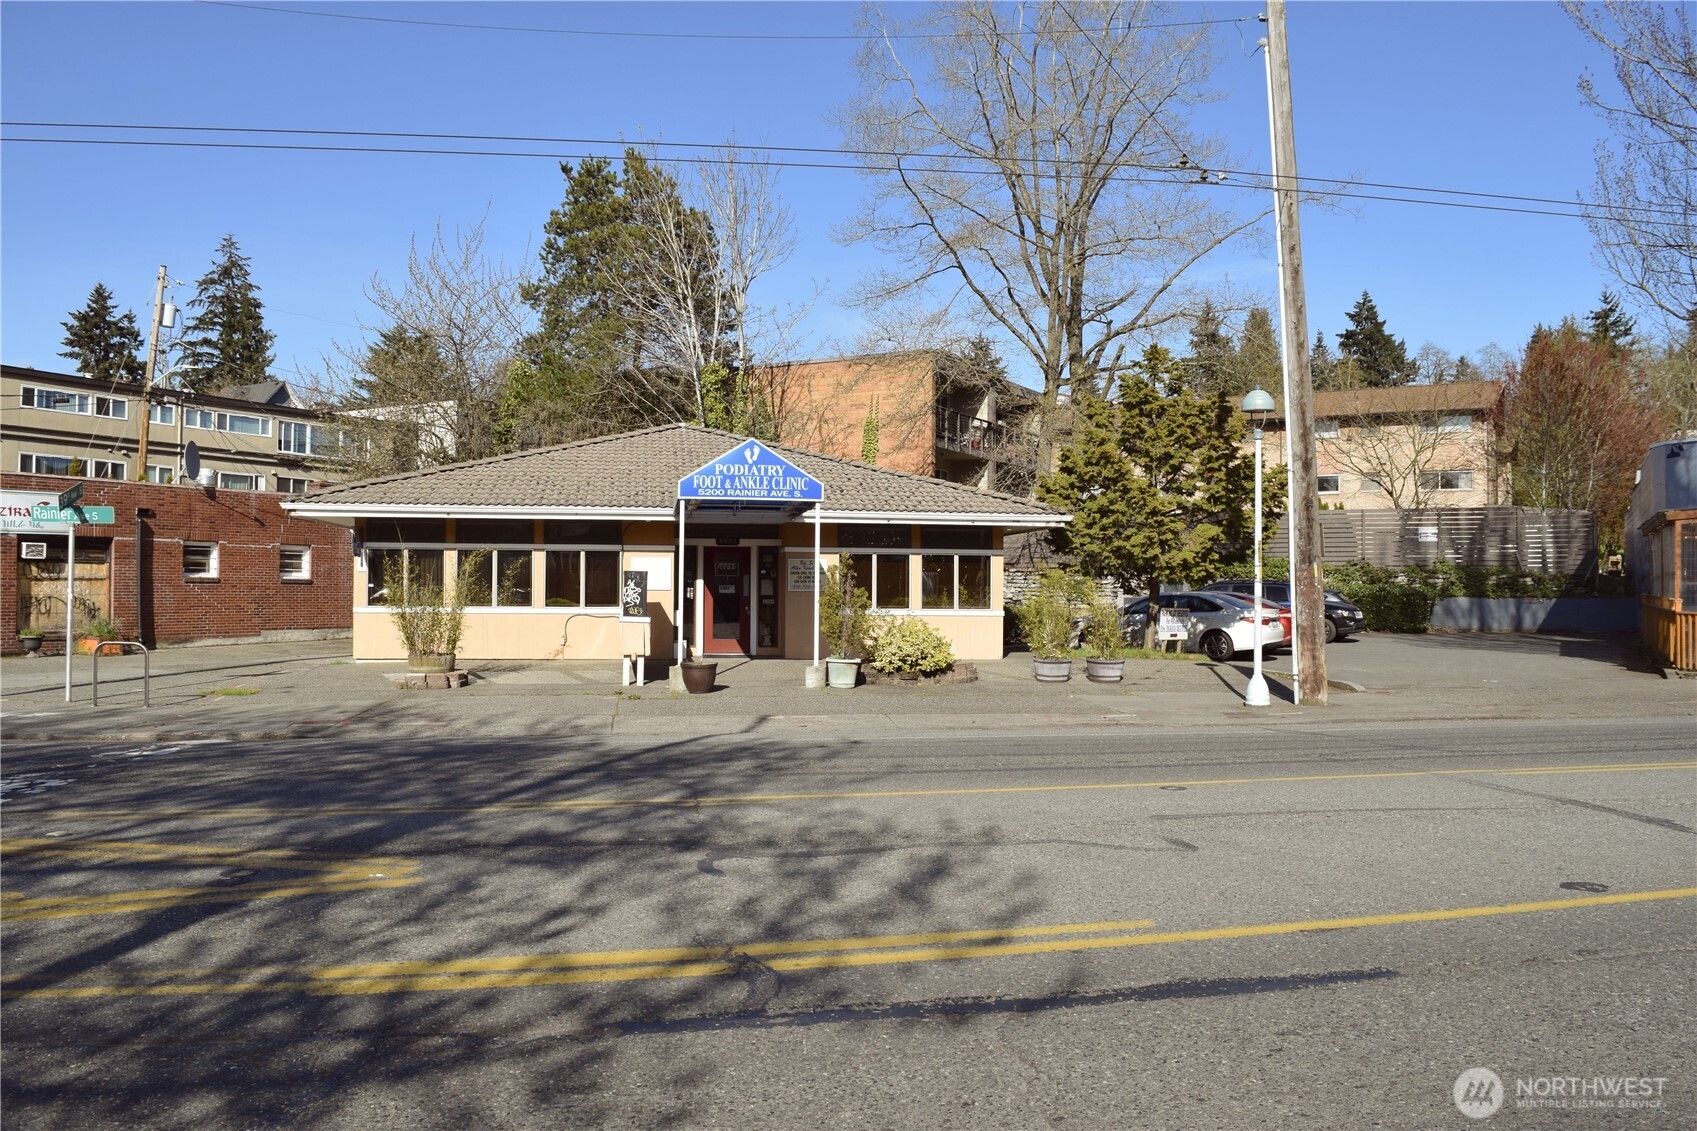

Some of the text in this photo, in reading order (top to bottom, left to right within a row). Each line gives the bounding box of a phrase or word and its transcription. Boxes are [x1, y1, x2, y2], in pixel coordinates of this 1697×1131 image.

[715, 463, 786, 476] PODIATRY
[693, 475, 809, 491] FOOT & ANKLE CLINIC
[698, 488, 725, 496] 5200
[727, 489, 768, 497] RAINIER
[794, 490, 803, 498] S.
[33, 506, 72, 520] Rainier
[92, 511, 99, 520] S
